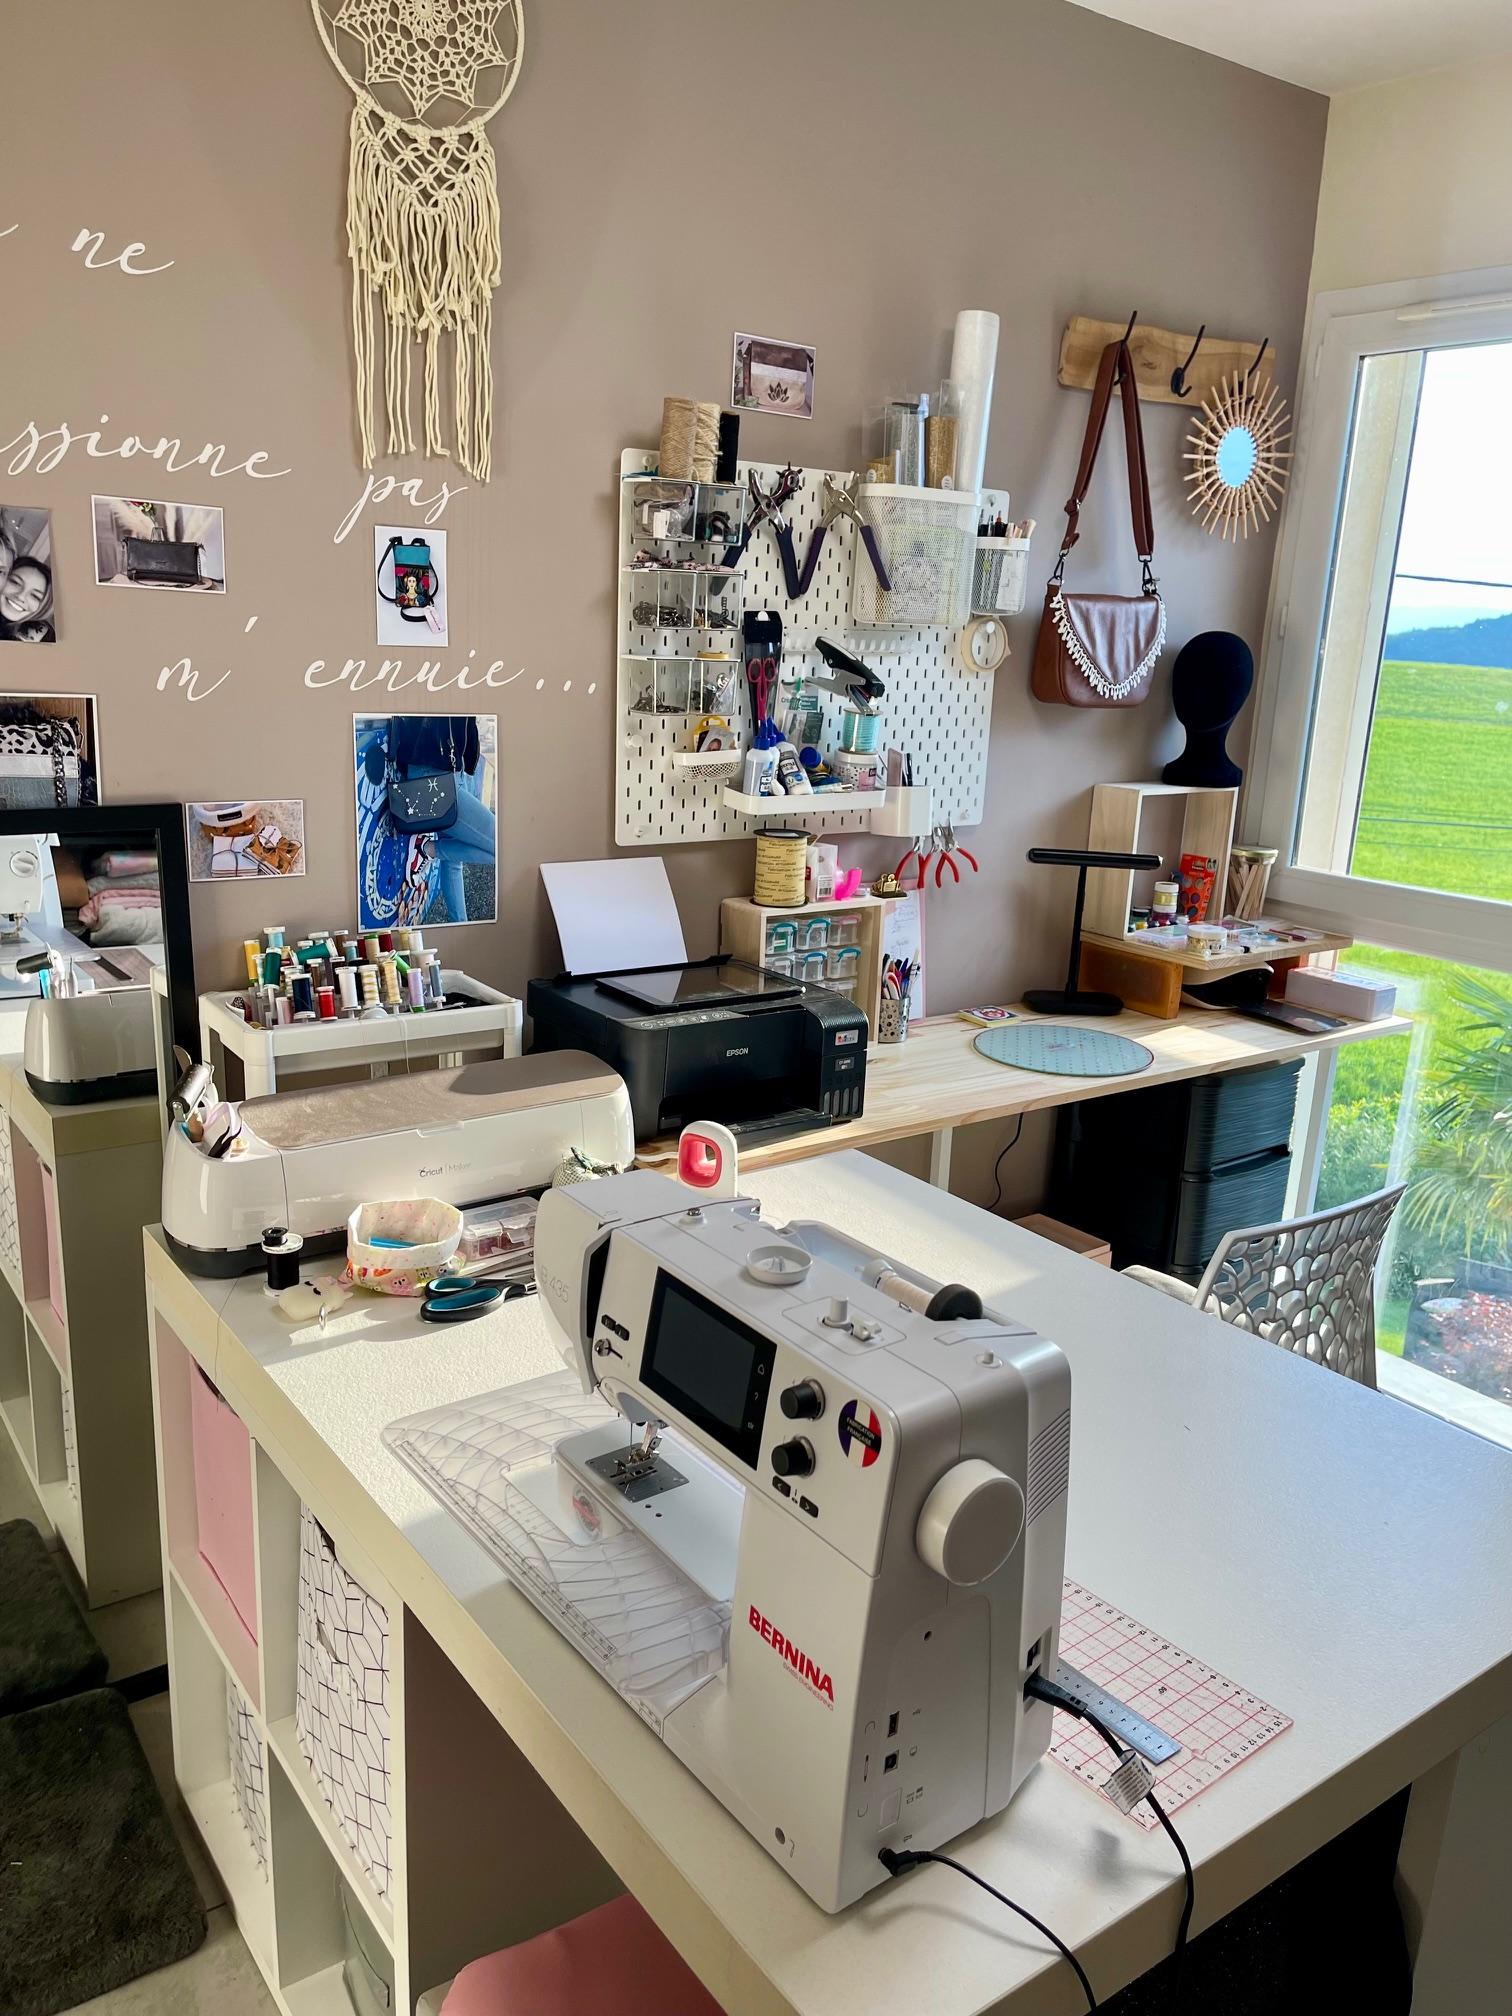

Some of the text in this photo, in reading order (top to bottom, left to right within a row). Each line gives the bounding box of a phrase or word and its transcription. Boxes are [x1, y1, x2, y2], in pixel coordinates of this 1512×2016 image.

[72, 228, 174, 274] ne
[333, 473, 468, 543] pas
[726, 1047, 749, 1057] EPSON
[418, 1166, 443, 1178] Cricut
[550, 1275, 569, 1303] 435
[749, 1604, 834, 1703] BERNINA
